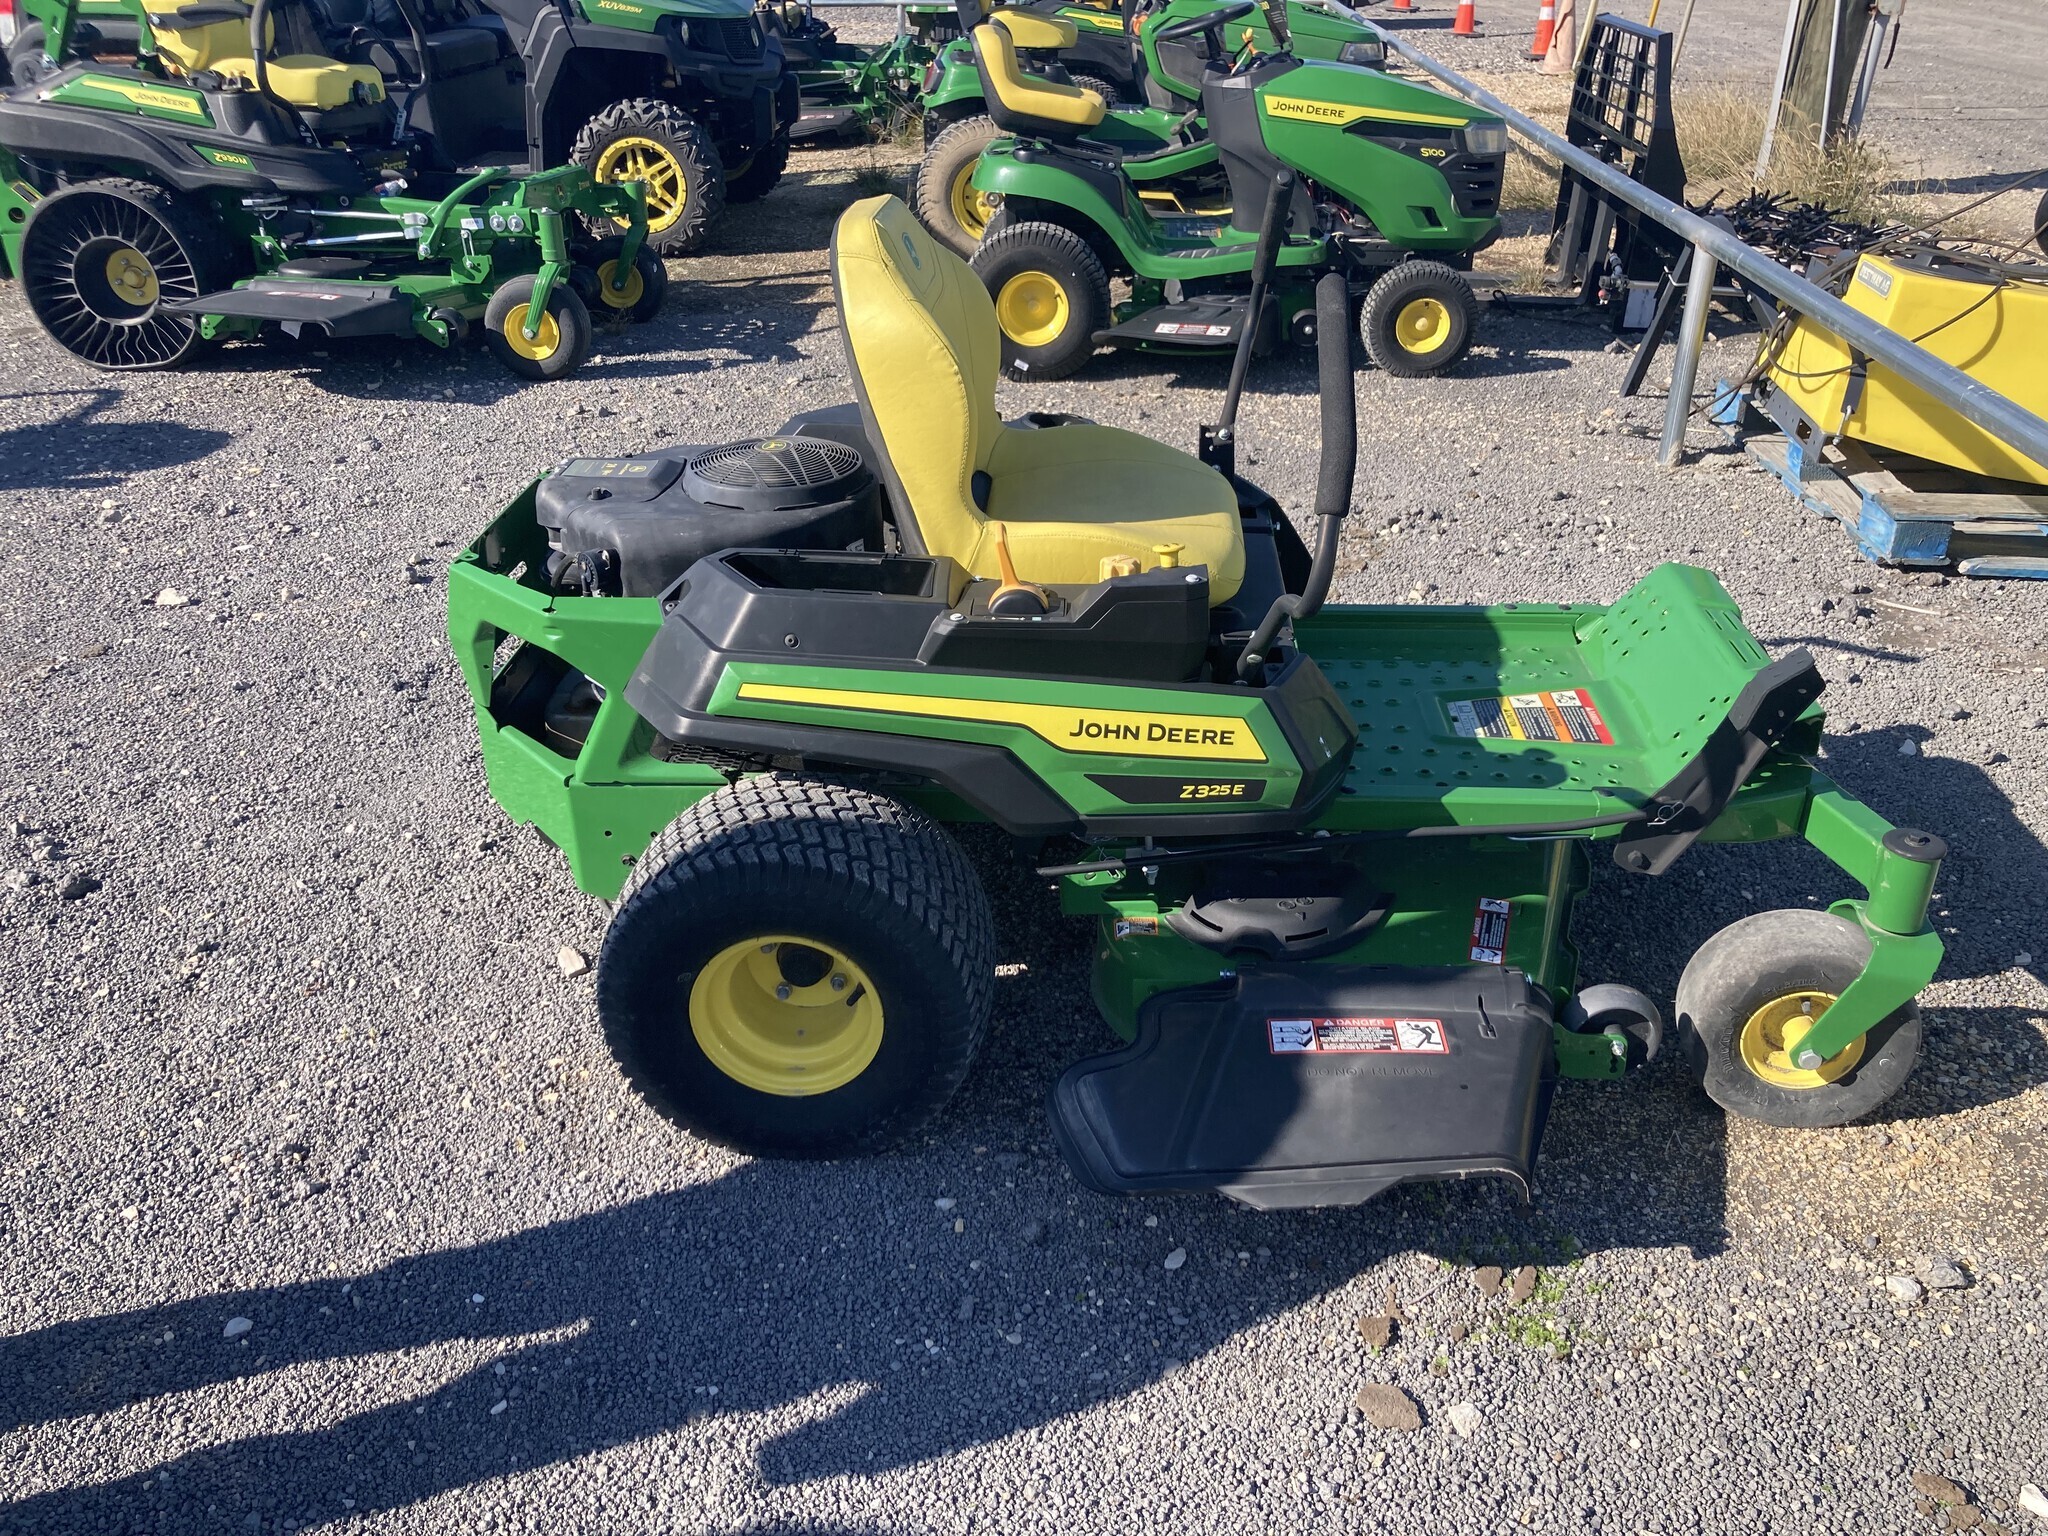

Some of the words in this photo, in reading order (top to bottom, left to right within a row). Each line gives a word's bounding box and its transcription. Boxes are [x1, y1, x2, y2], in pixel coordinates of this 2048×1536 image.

[135, 92, 158, 102] JOHN
[160, 96, 190, 109] DEERE
[1273, 101, 1304, 114] JOHN
[1306, 105, 1345, 119] DEERE
[1420, 147, 1446, 158] S100
[1069, 719, 1141, 741] JOHN
[1147, 723, 1235, 746] DEERE
[1336, 1018, 1385, 1026] DANGER
